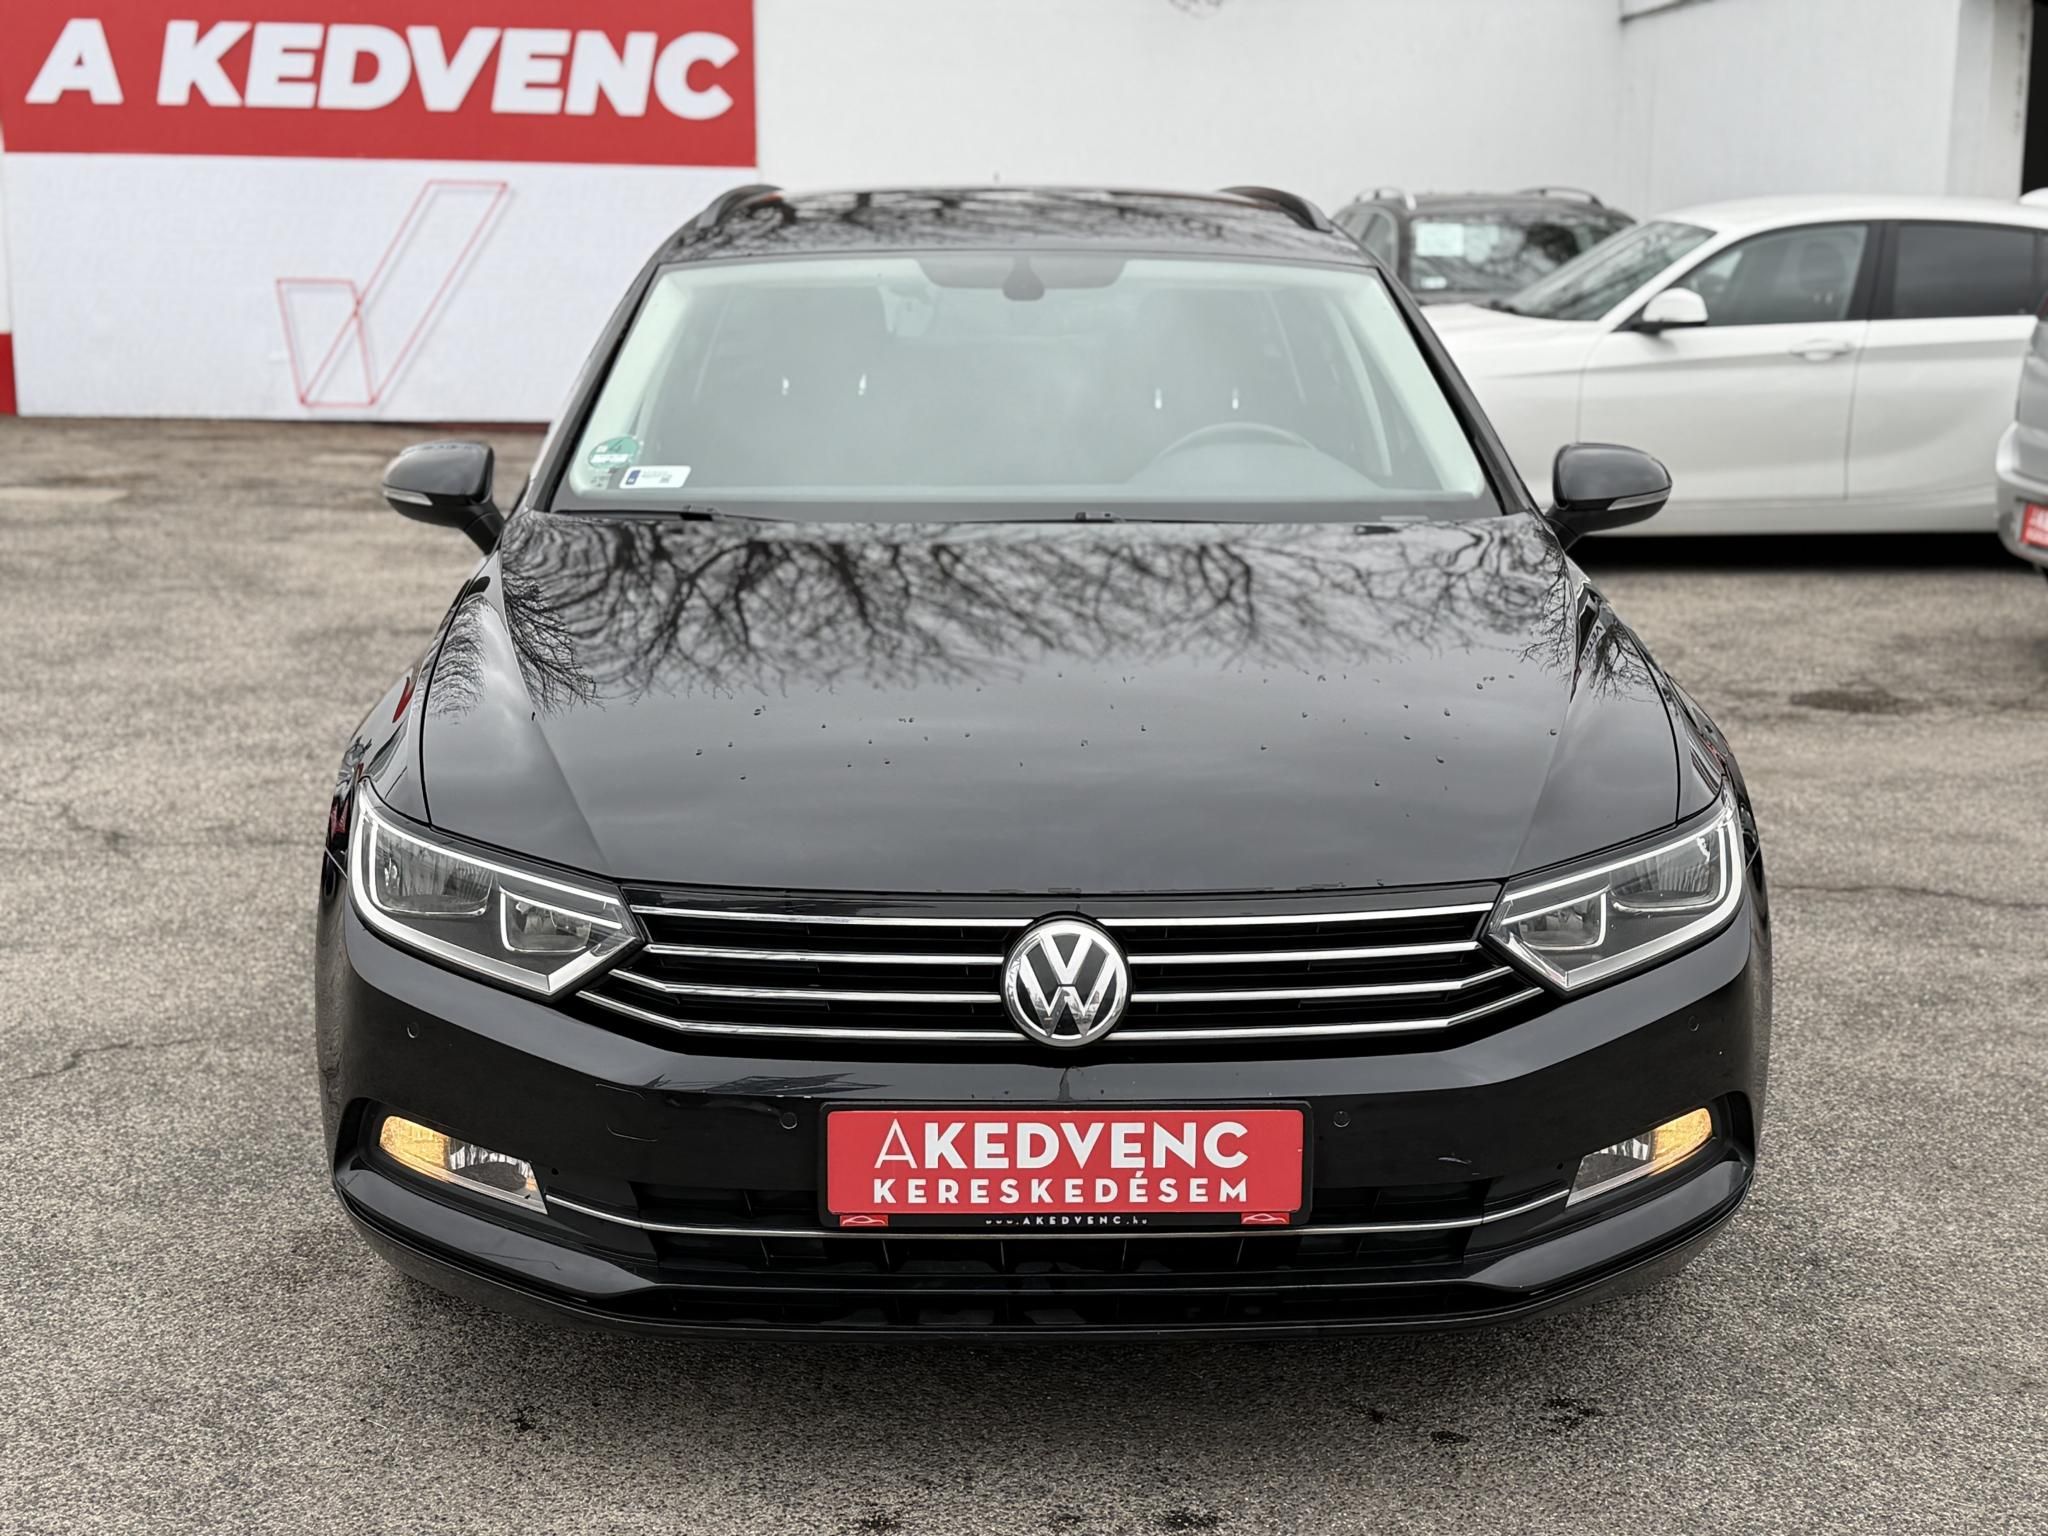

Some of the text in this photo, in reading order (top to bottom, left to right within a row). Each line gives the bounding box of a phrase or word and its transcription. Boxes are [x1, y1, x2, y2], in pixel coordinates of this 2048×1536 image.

[25, 18, 740, 120] A KEDVENC
[873, 1118, 1250, 1169] AKEDVENC
[873, 1171, 1248, 1205] KERESKEDÉSEM
